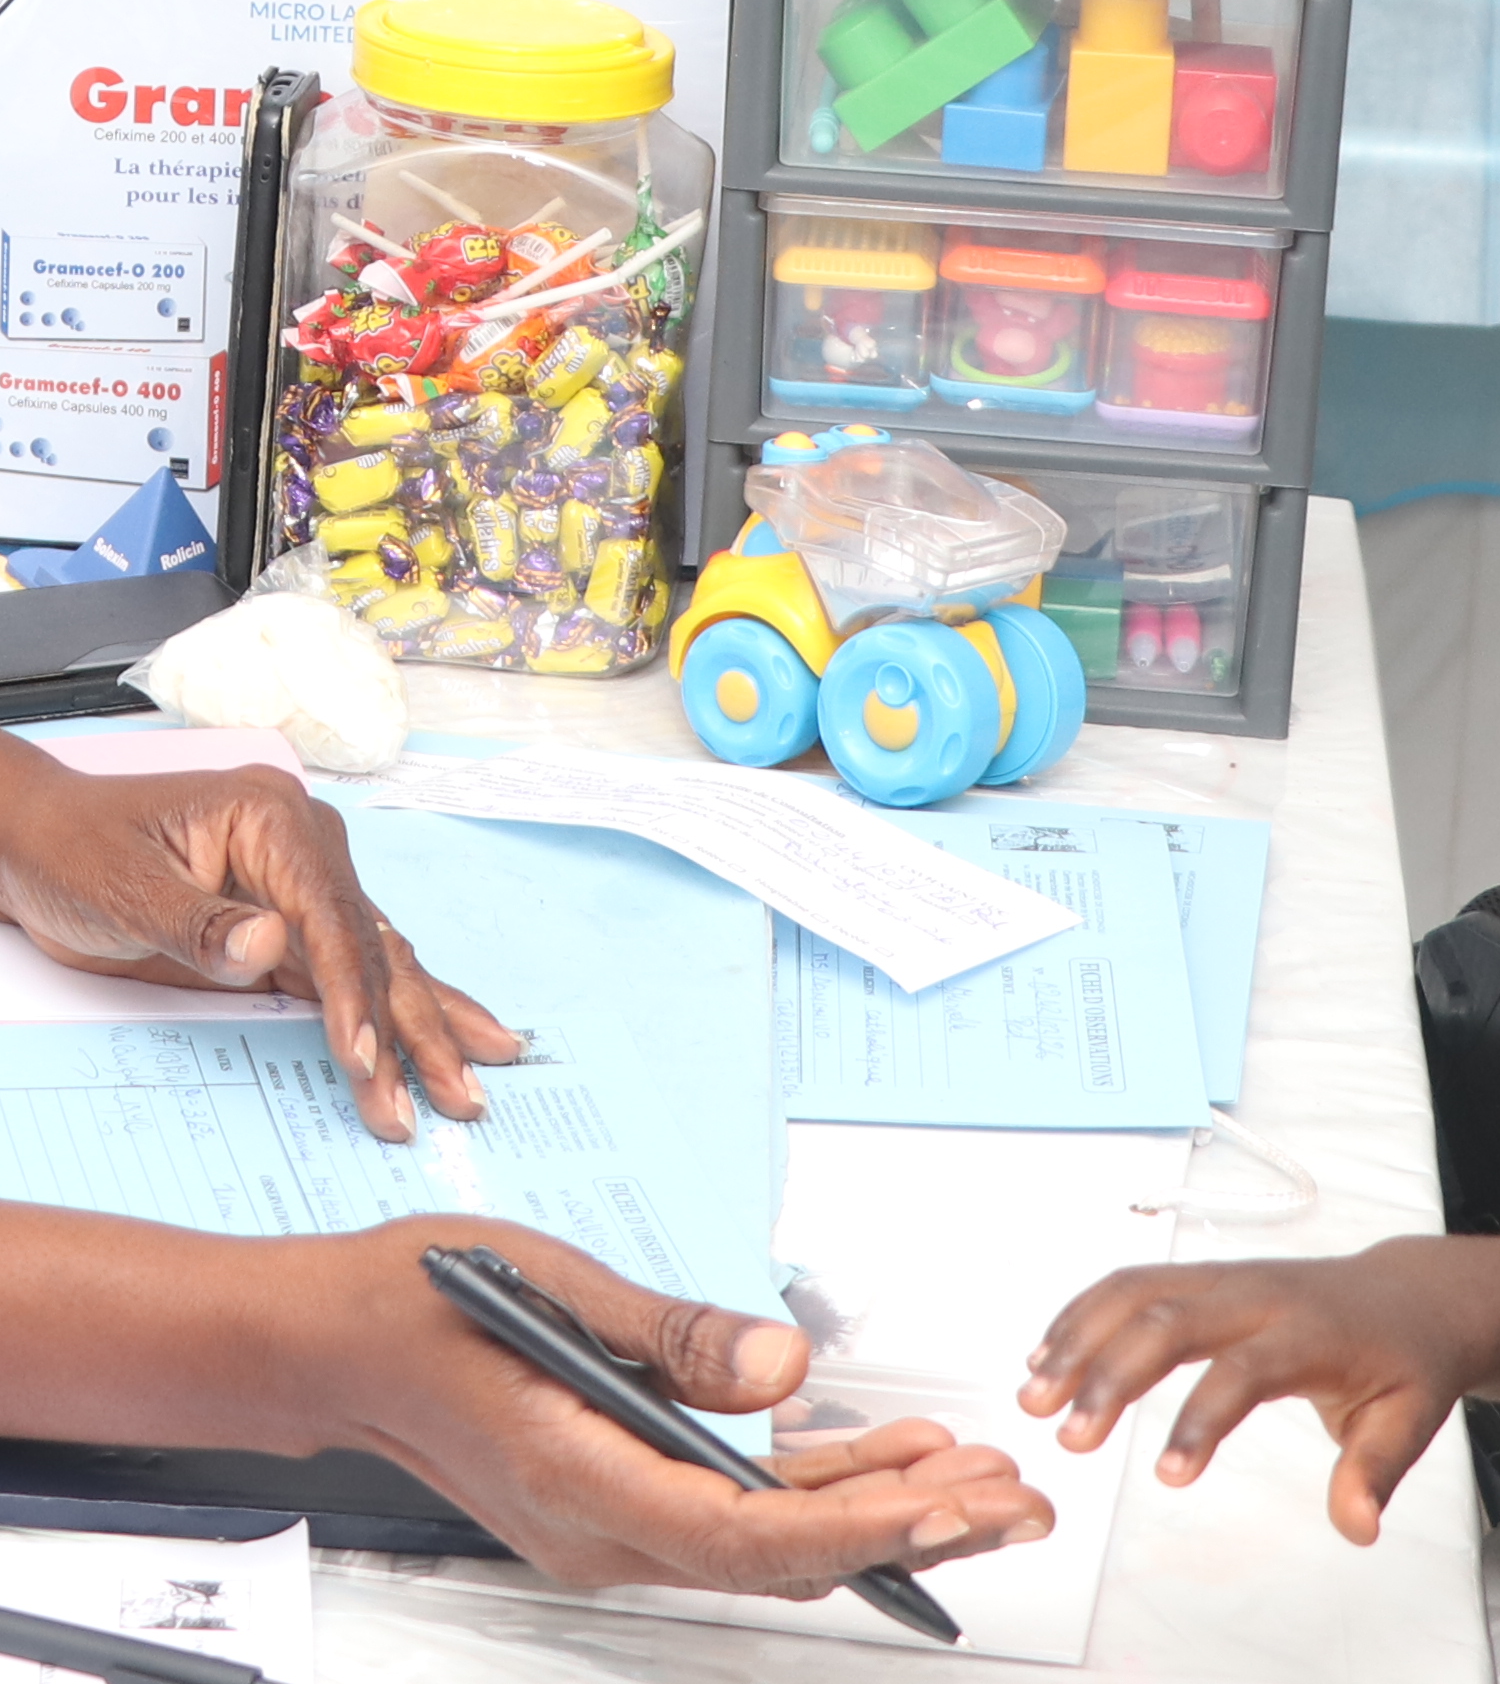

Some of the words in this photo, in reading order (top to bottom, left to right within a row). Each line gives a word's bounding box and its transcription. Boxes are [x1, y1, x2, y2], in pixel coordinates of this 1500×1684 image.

[250, 1, 325, 21] MICRO
[94, 127, 156, 144] Cefixime
[160, 129, 187, 144] 200
[191, 131, 206, 145] et
[208, 131, 237, 145] 400
[114, 157, 141, 176] La
[148, 158, 243, 184] thérapie
[126, 186, 181, 208] pour
[187, 185, 219, 206] les
[33, 258, 145, 278] Gramocef-O
[152, 263, 185, 279] 200
[47, 277, 88, 289] Cefixime
[91, 279, 134, 292] Capsules
[137, 281, 155, 292] 200
[157, 284, 171, 294] mg
[137, 381, 182, 401] 400
[7, 395, 58, 411] Cefixime
[61, 399, 117, 415] Capsules
[120, 403, 144, 417] 400
[147, 407, 168, 421] mg
[93, 536, 130, 572] Solexim
[159, 540, 206, 571] Rolicin
[1078, 960, 1103, 995] FICHE
[1082, 994, 1114, 1088] D'OBSERVATIONS
[603, 1180, 643, 1216] FICHE
[622, 1213, 694, 1303] D'OBSERVATION
